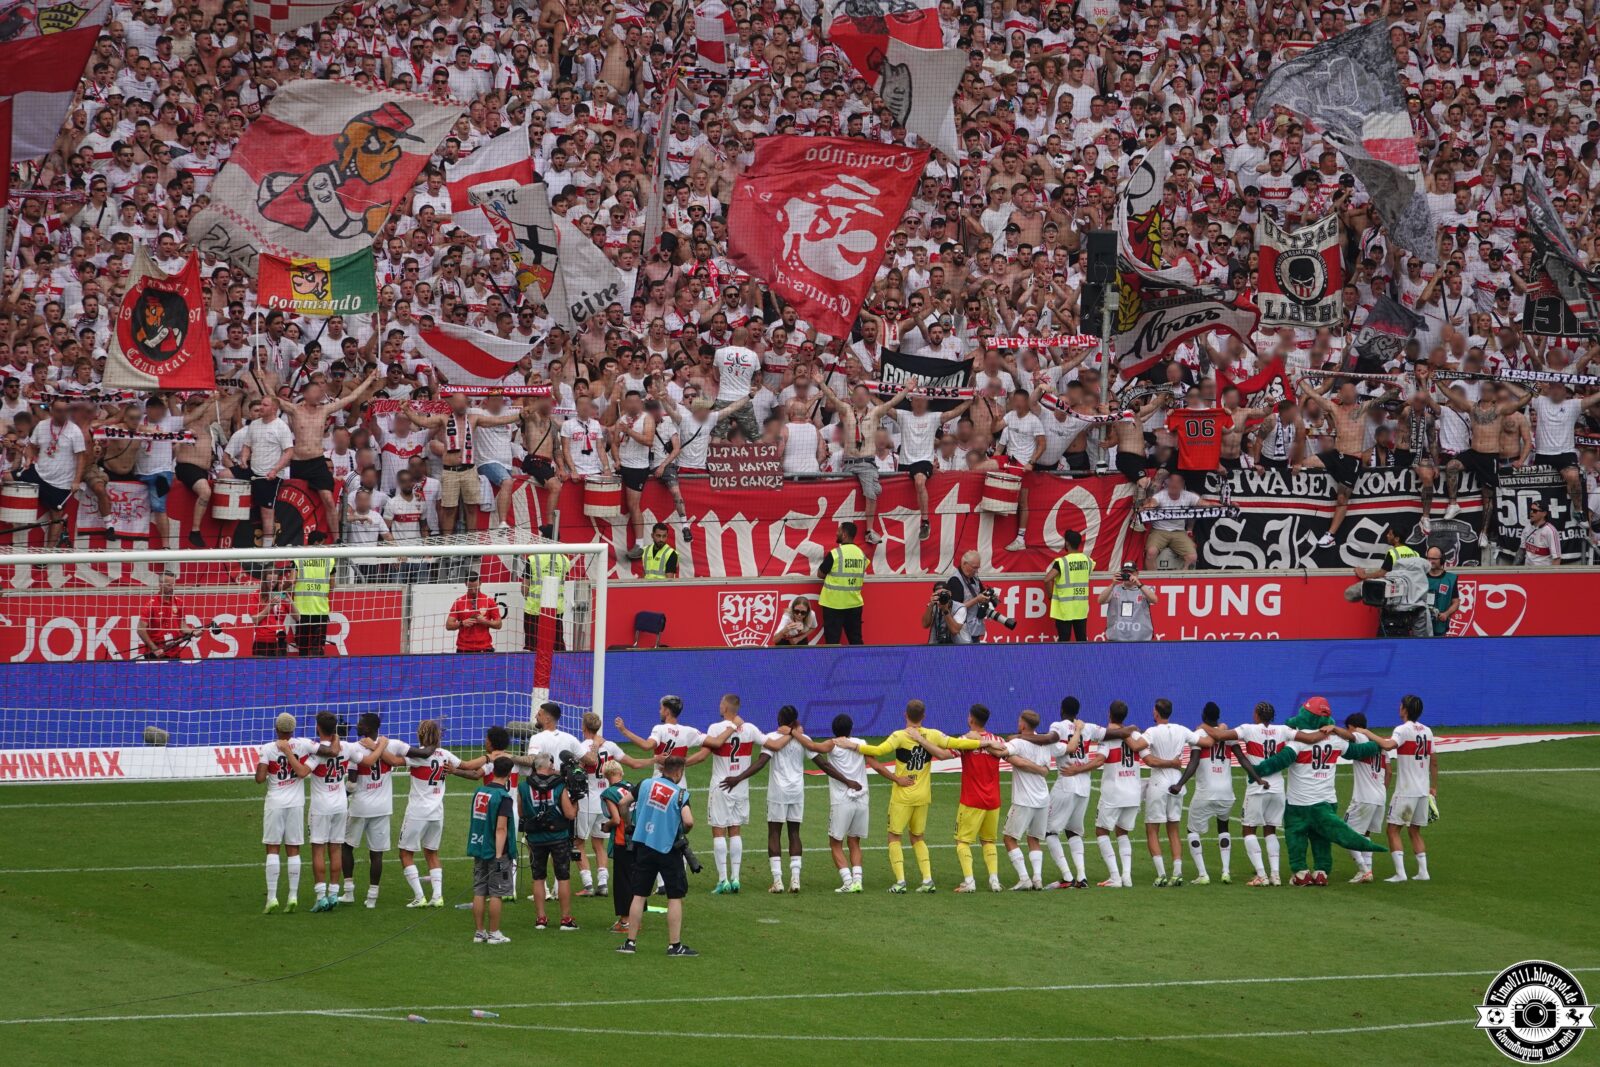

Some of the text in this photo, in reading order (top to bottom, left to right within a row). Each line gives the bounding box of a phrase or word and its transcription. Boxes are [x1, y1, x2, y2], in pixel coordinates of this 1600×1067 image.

[1263, 217, 1338, 248] ULTRAS
[119, 309, 132, 323] 19
[188, 308, 202, 324] 97
[1501, 368, 1598, 385] KESSELSTADT
[1185, 419, 1215, 438] 06
[754, 445, 777, 457] IST
[708, 461, 781, 472] DER KAMPF
[710, 475, 784, 489] UMS GANZE
[1140, 507, 1229, 522] KESSELSTADT
[844, 558, 863, 569] SECURITY
[1069, 561, 1089, 572] SECURITY
[730, 736, 741, 763] 2
[1414, 734, 1428, 761] 21
[1311, 744, 1333, 770] 92
[325, 756, 346, 784] 25
[470, 833, 485, 845] 24
